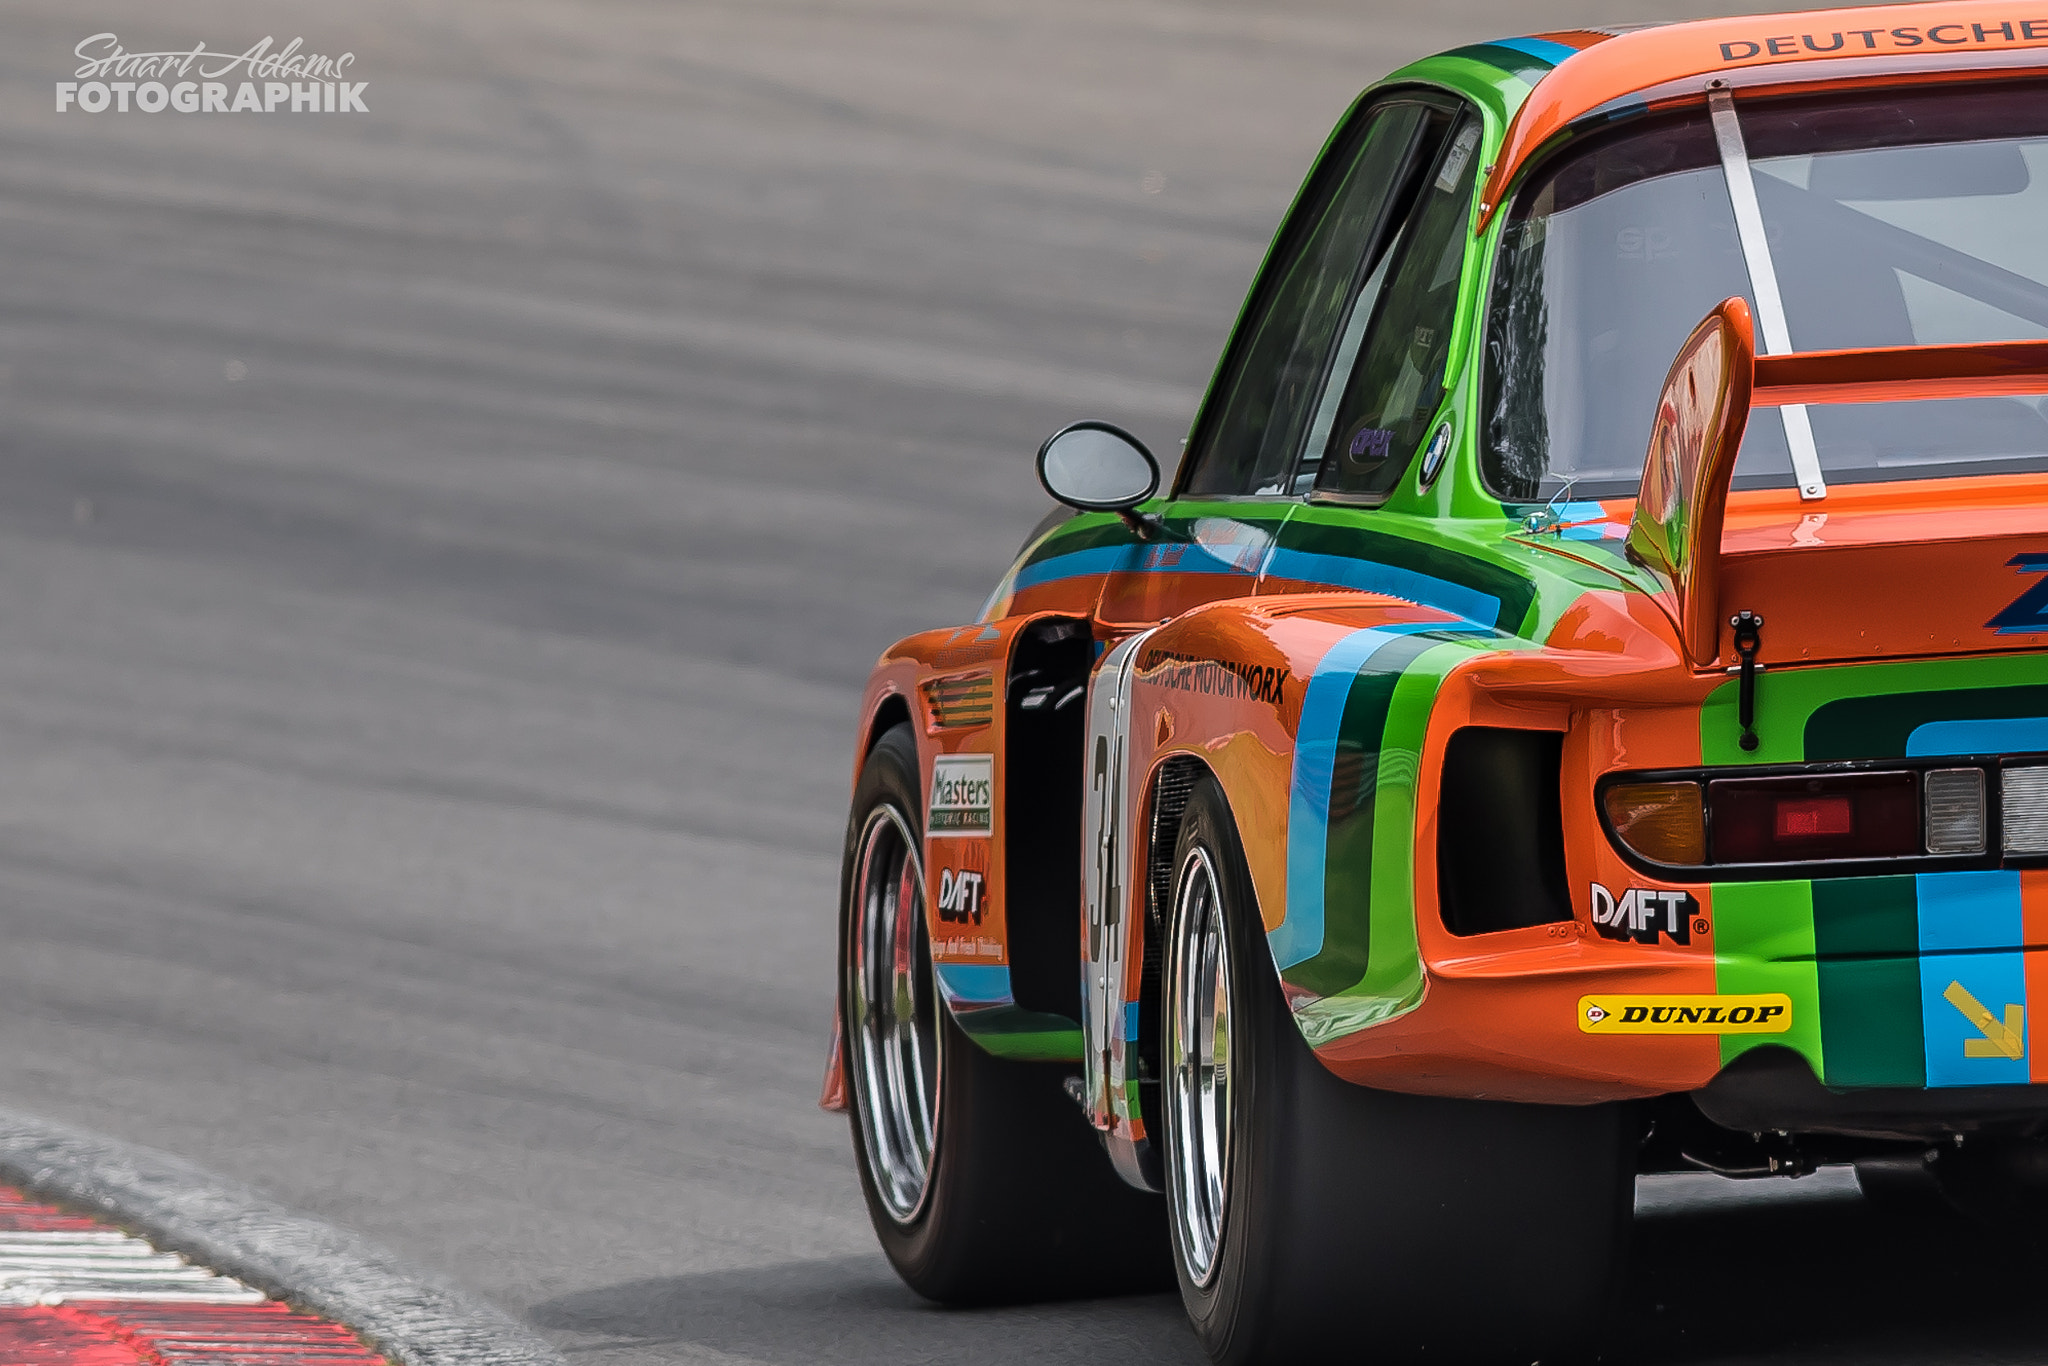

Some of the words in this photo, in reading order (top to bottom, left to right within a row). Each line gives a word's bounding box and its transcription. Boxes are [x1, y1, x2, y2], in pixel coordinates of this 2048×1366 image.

[1719, 20, 2048, 61] DEUTSCHE
[932, 768, 990, 805] Masters
[938, 867, 983, 917] DAFT
[1590, 882, 1692, 937] DAFT
[1618, 1006, 1784, 1024] DUNLOP
